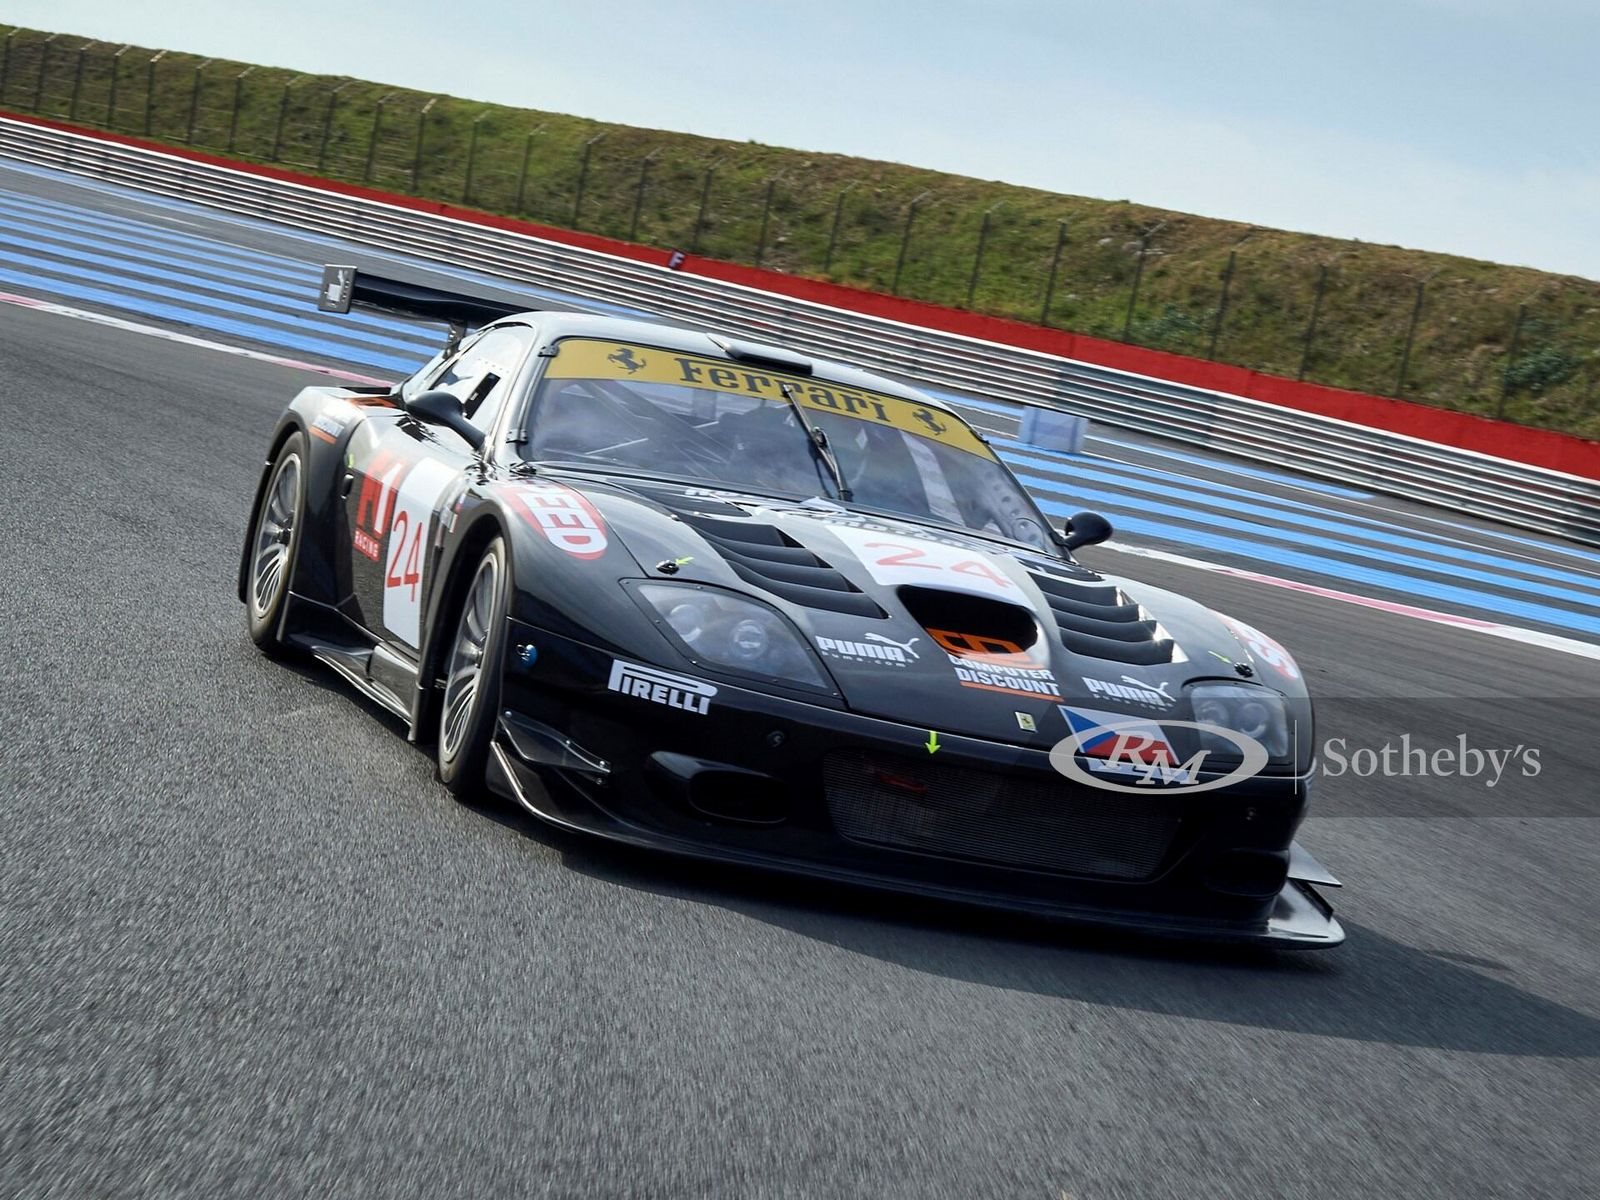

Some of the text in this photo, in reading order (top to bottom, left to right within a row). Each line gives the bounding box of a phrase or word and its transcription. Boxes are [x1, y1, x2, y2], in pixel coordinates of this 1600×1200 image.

[669, 251, 685, 268] F
[673, 357, 891, 423] Ferrari
[387, 510, 422, 602] 24
[864, 542, 1013, 588] 24
[815, 635, 906, 662] PUMA
[948, 653, 1056, 681] COMPUTER
[954, 667, 1061, 696] DISCOUNT
[608, 659, 718, 715] PIRELLI
[1081, 676, 1166, 706] PUMA
